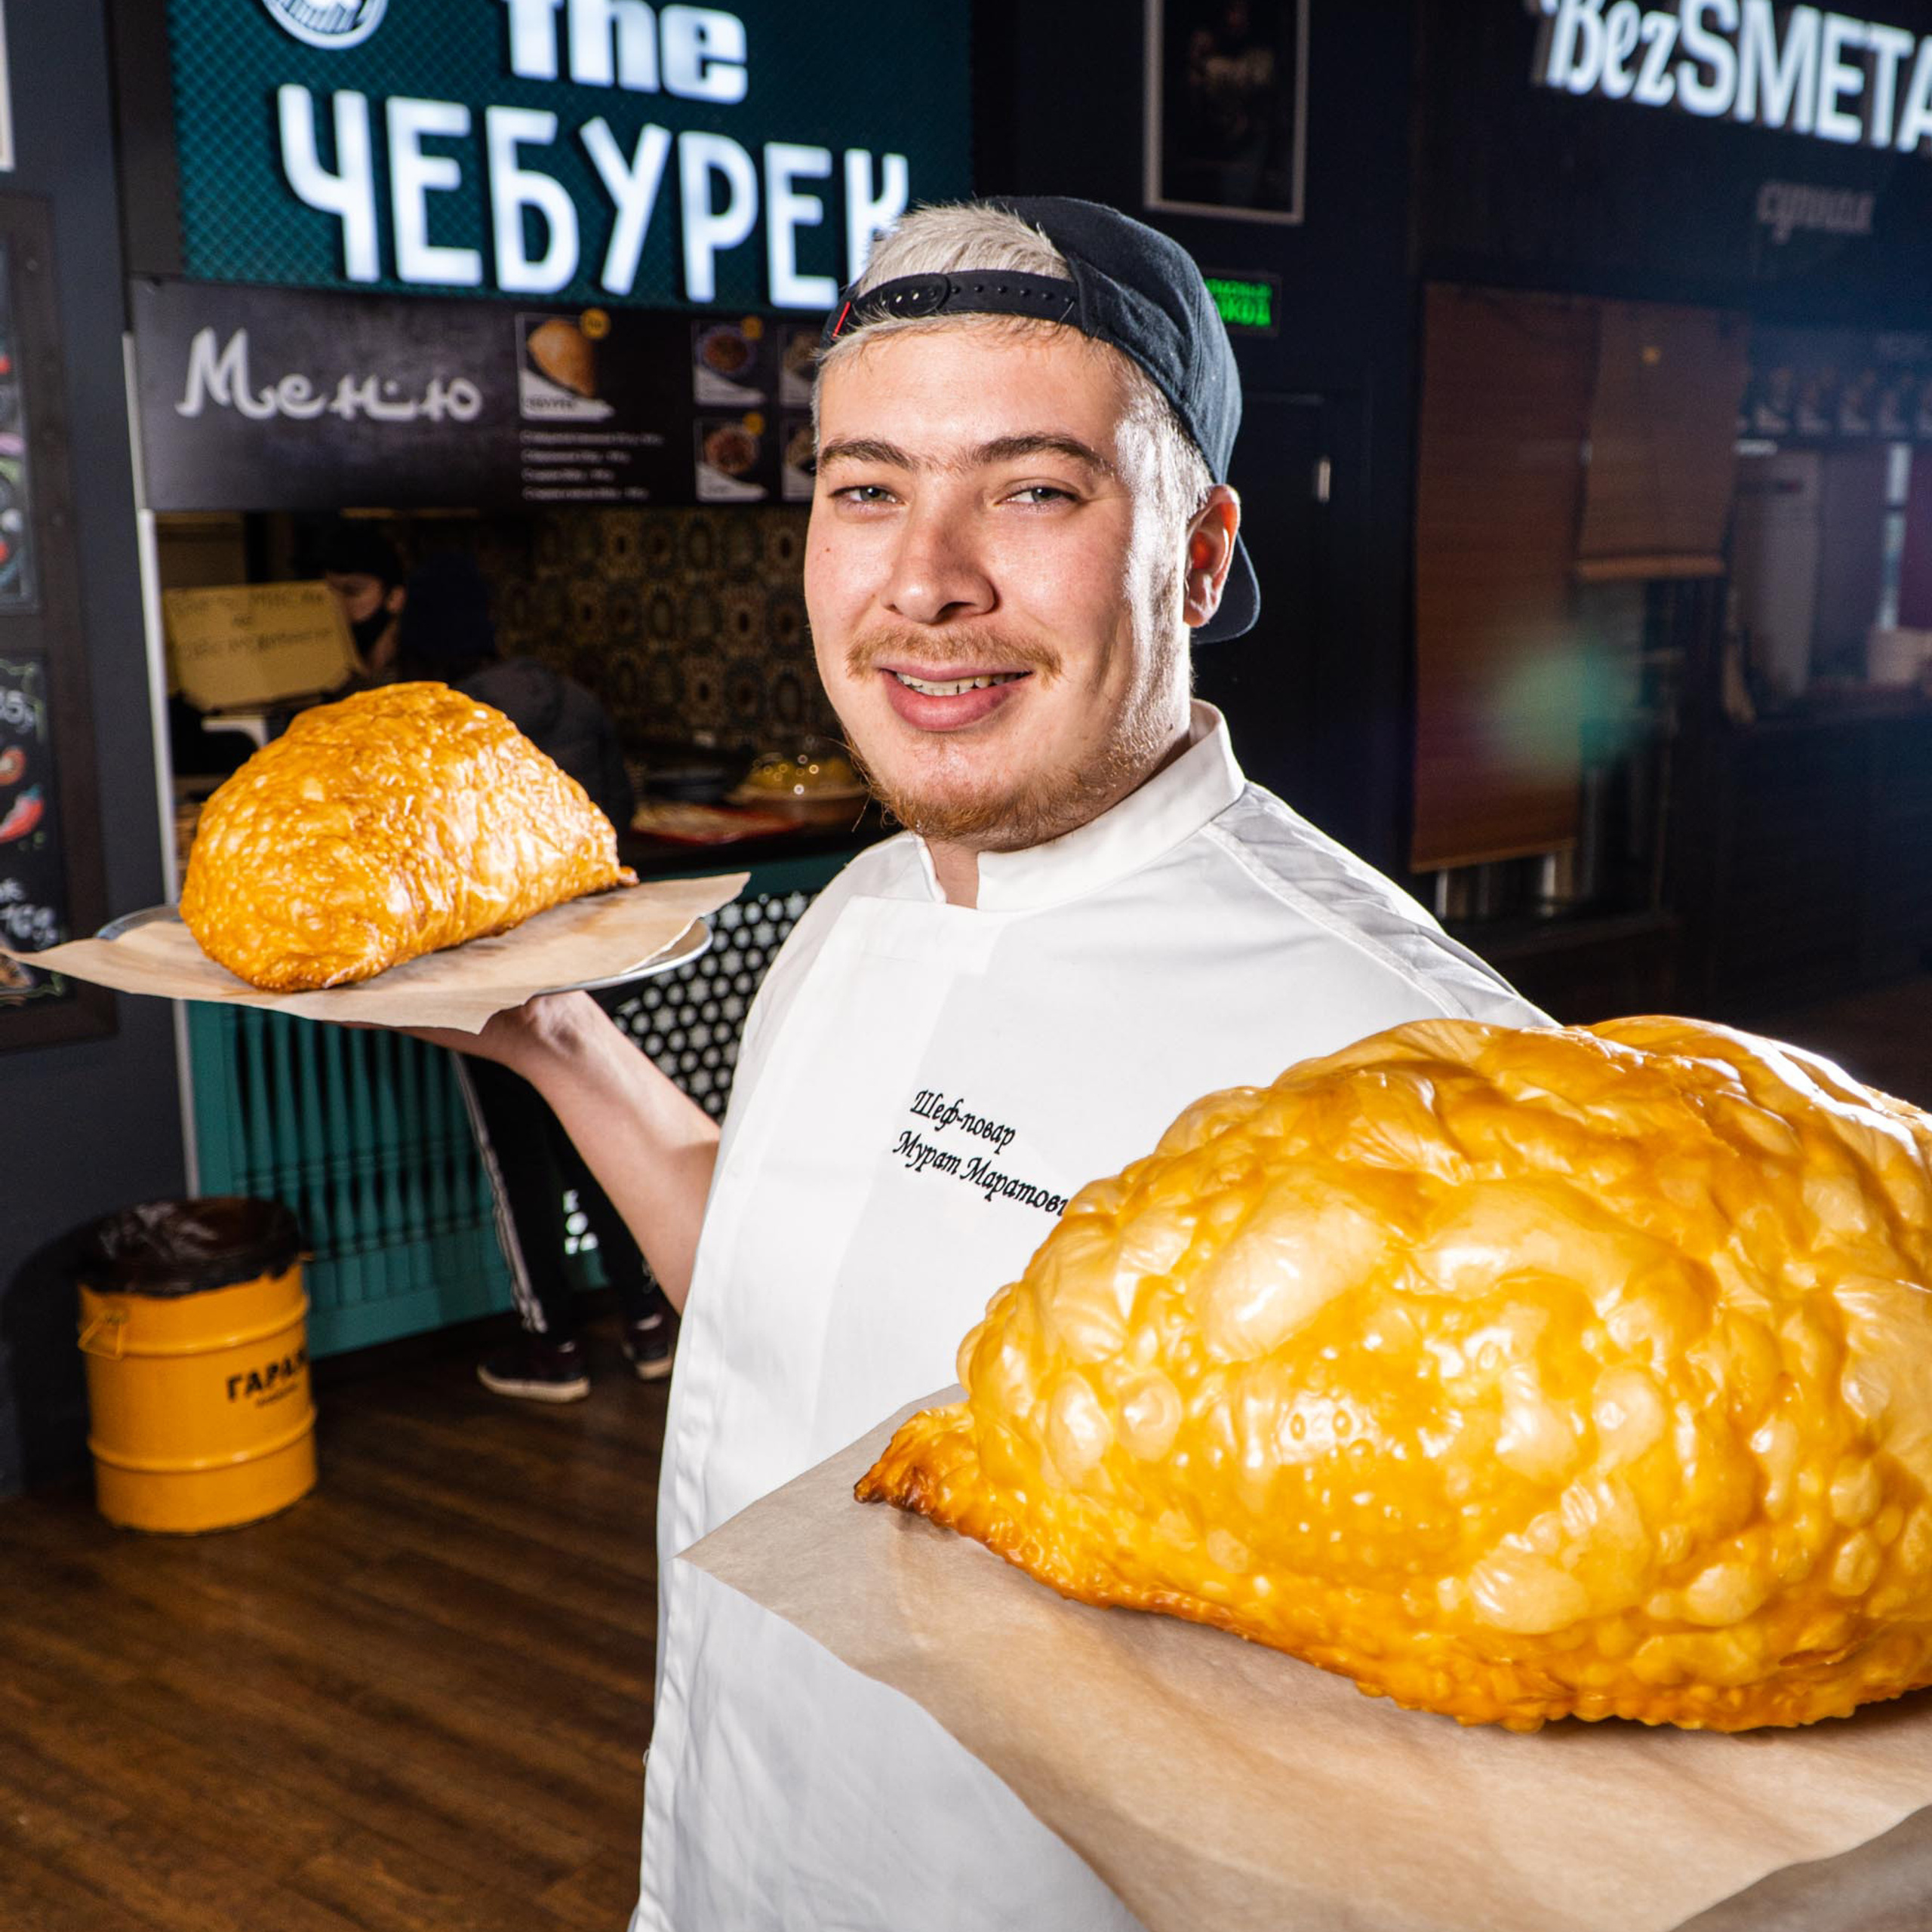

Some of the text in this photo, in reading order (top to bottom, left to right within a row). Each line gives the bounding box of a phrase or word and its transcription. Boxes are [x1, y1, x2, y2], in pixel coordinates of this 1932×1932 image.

[277, 84, 909, 310] ЧЕБУРЕК
[174, 325, 482, 421] Меню
[892, 1130, 962, 1173] Мурат
[909, 1089, 1016, 1155] Шеф-повар
